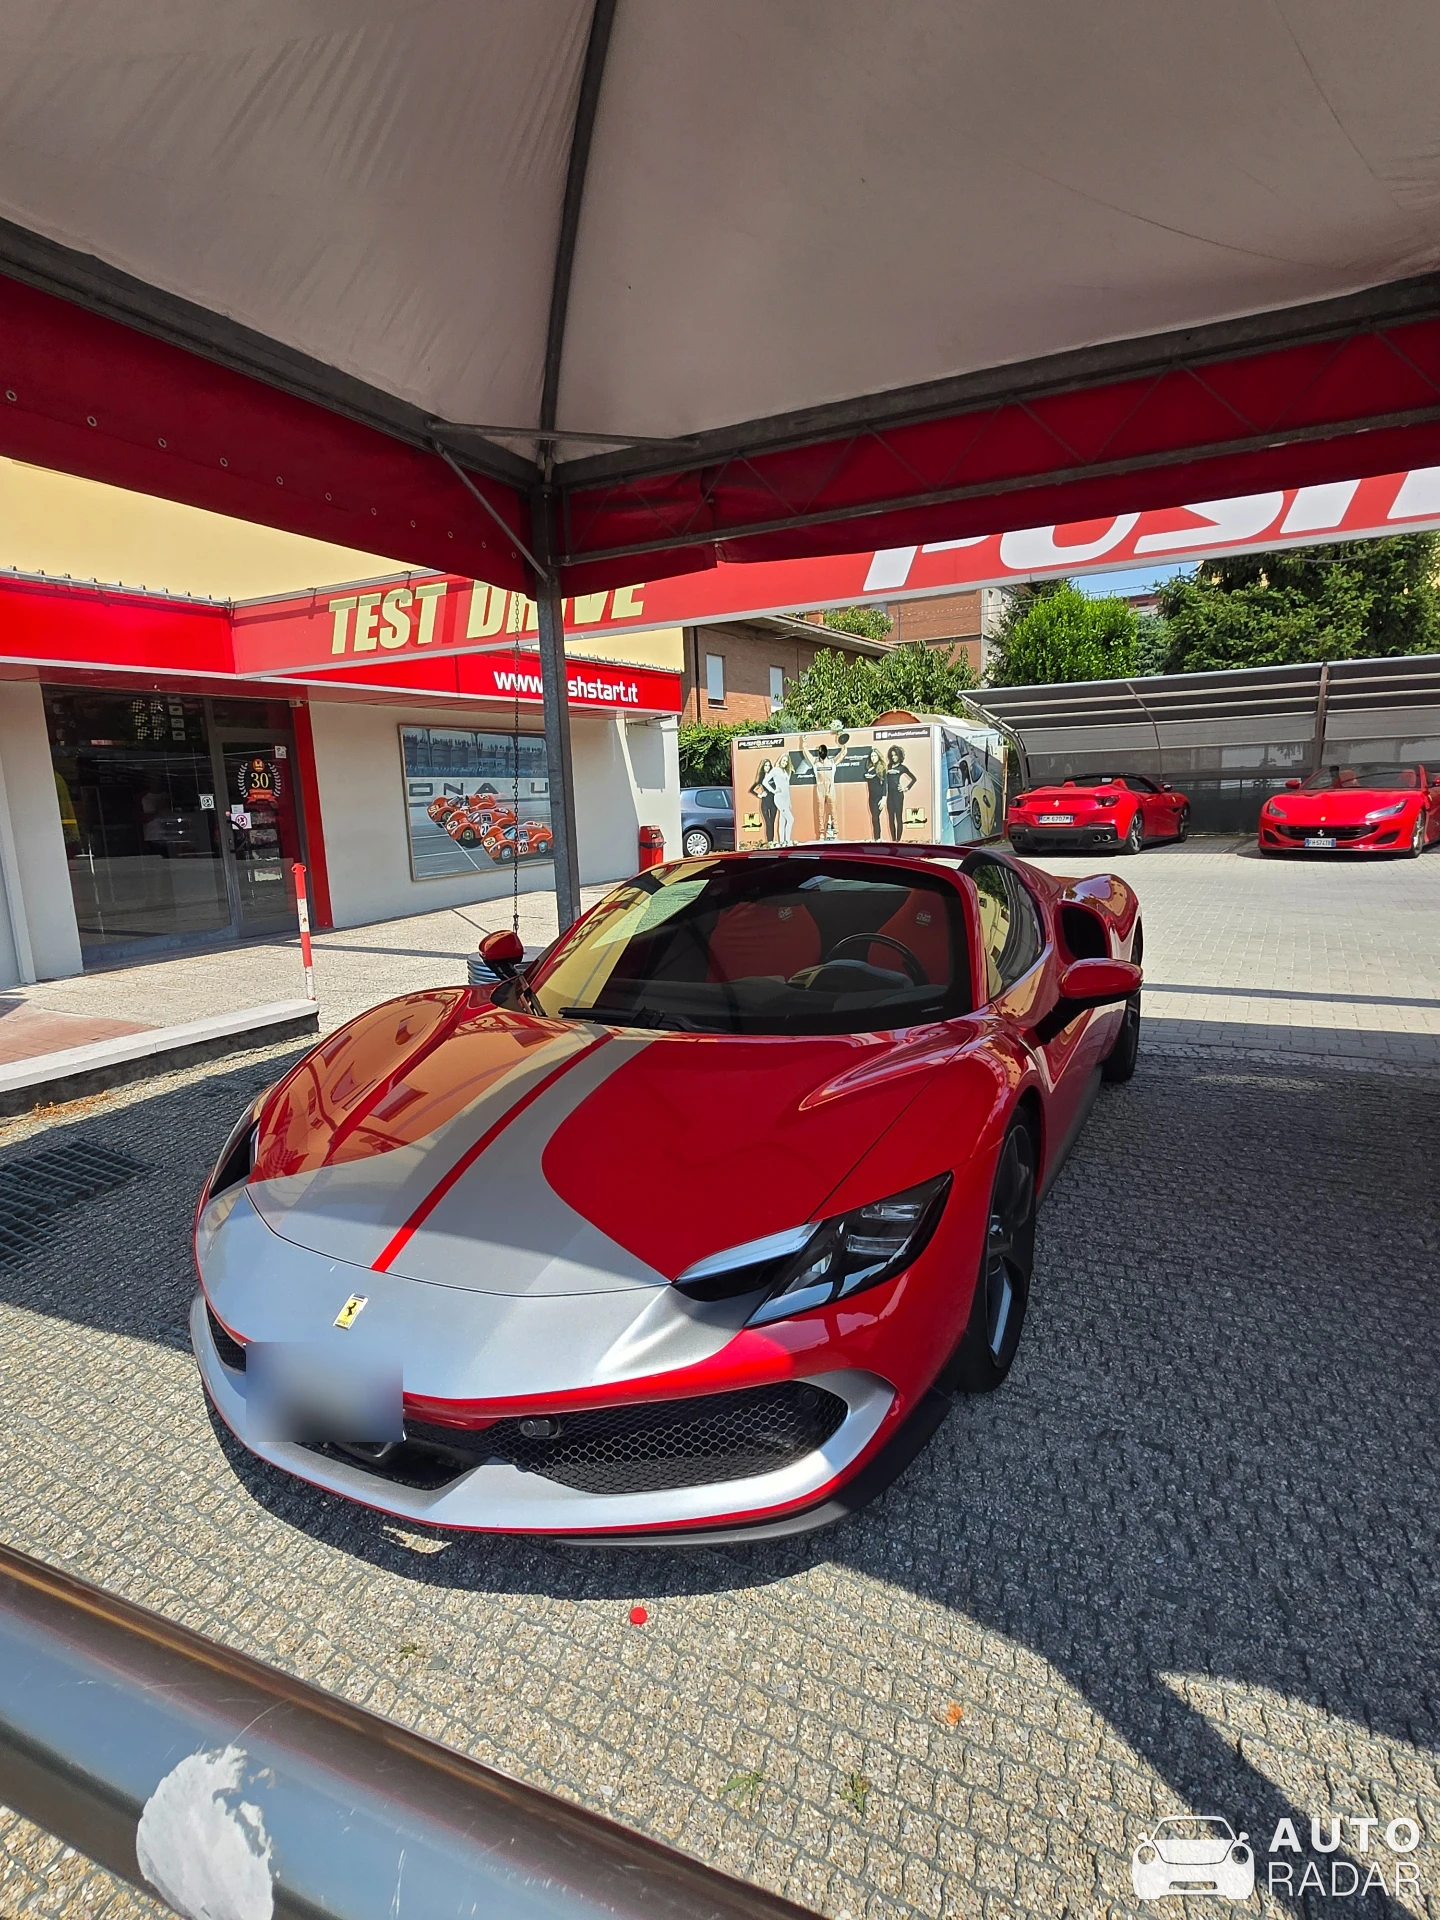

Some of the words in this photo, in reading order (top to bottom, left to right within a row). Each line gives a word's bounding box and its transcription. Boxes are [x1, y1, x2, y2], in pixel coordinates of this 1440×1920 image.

[329, 582, 447, 655] TEST
[466, 580, 645, 639] DRVE
[493, 671, 638, 703] wwwshstart.it
